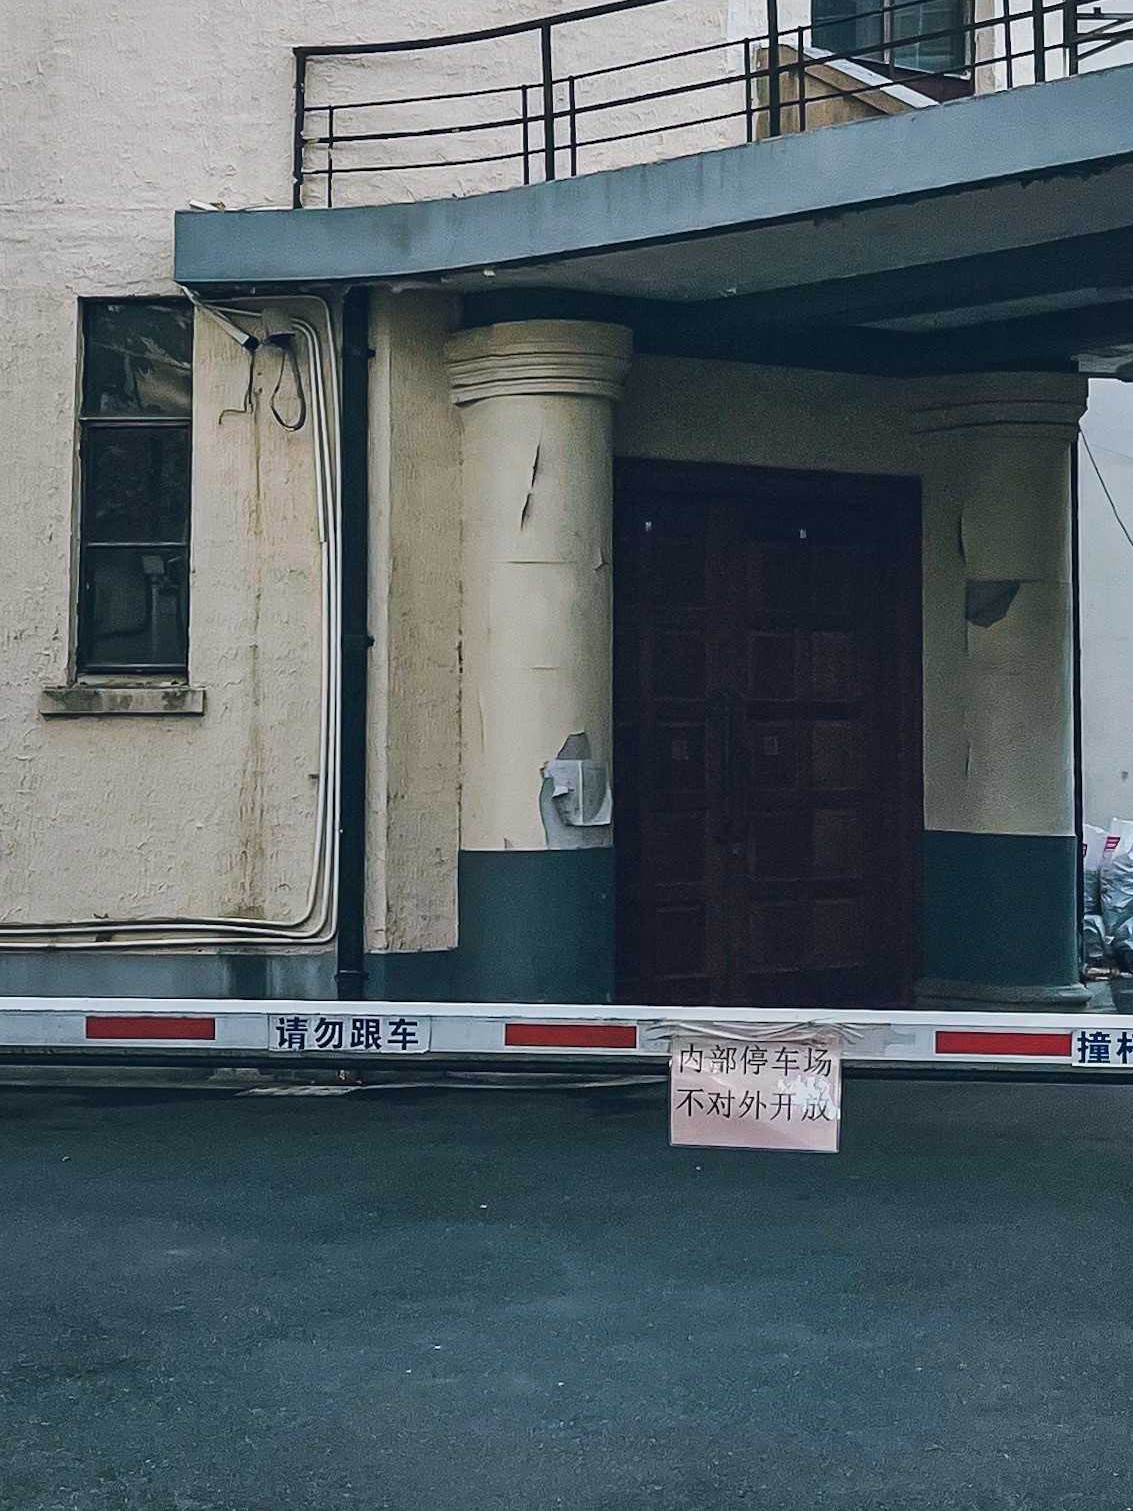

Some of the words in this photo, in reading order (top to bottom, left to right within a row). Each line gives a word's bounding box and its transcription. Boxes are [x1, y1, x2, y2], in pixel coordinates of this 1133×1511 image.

[276, 1016, 419, 1050] 请勿跟车
[679, 1043, 832, 1077] 内部停车场
[675, 1088, 831, 1121] 不对外开放
